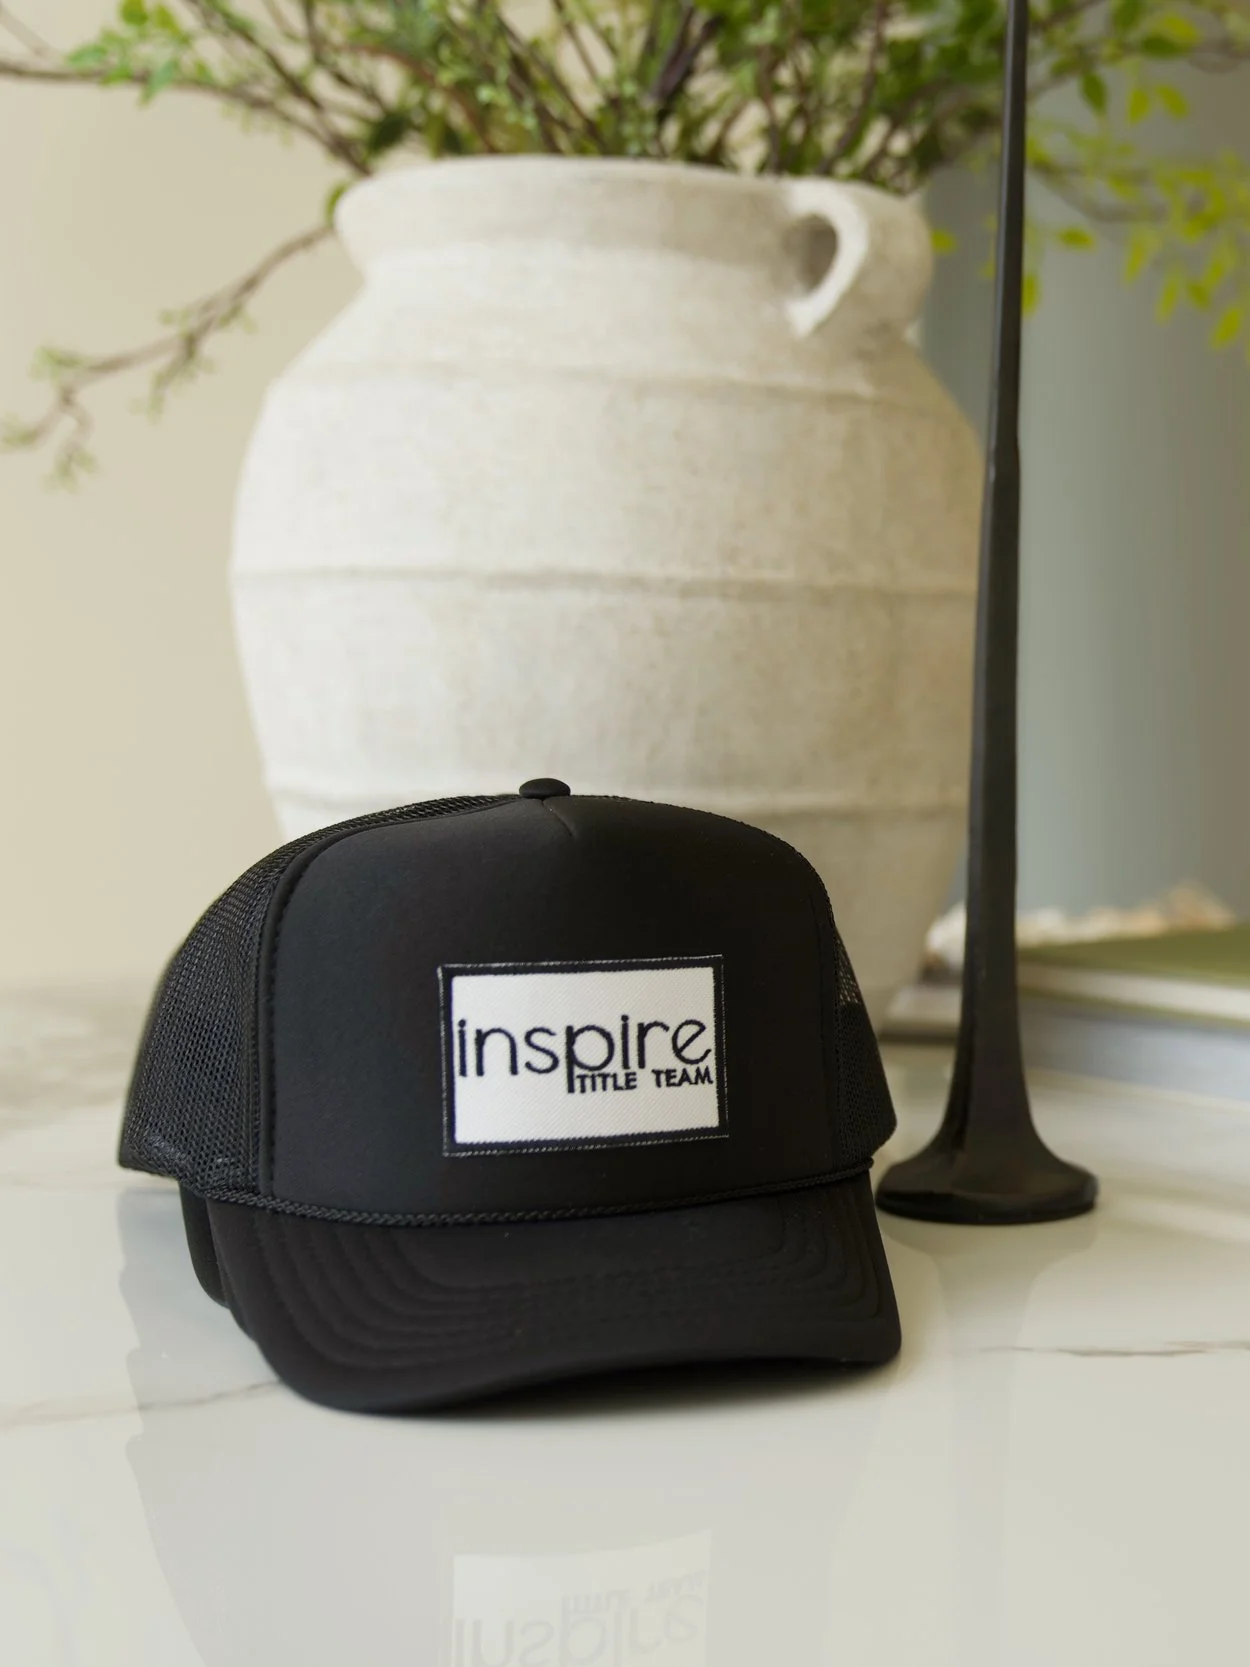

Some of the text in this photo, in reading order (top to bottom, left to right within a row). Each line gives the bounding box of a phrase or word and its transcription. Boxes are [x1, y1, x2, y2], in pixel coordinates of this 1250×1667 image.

[458, 1015, 712, 1093] inspire
[576, 1065, 714, 1094] TITLE TEAM
